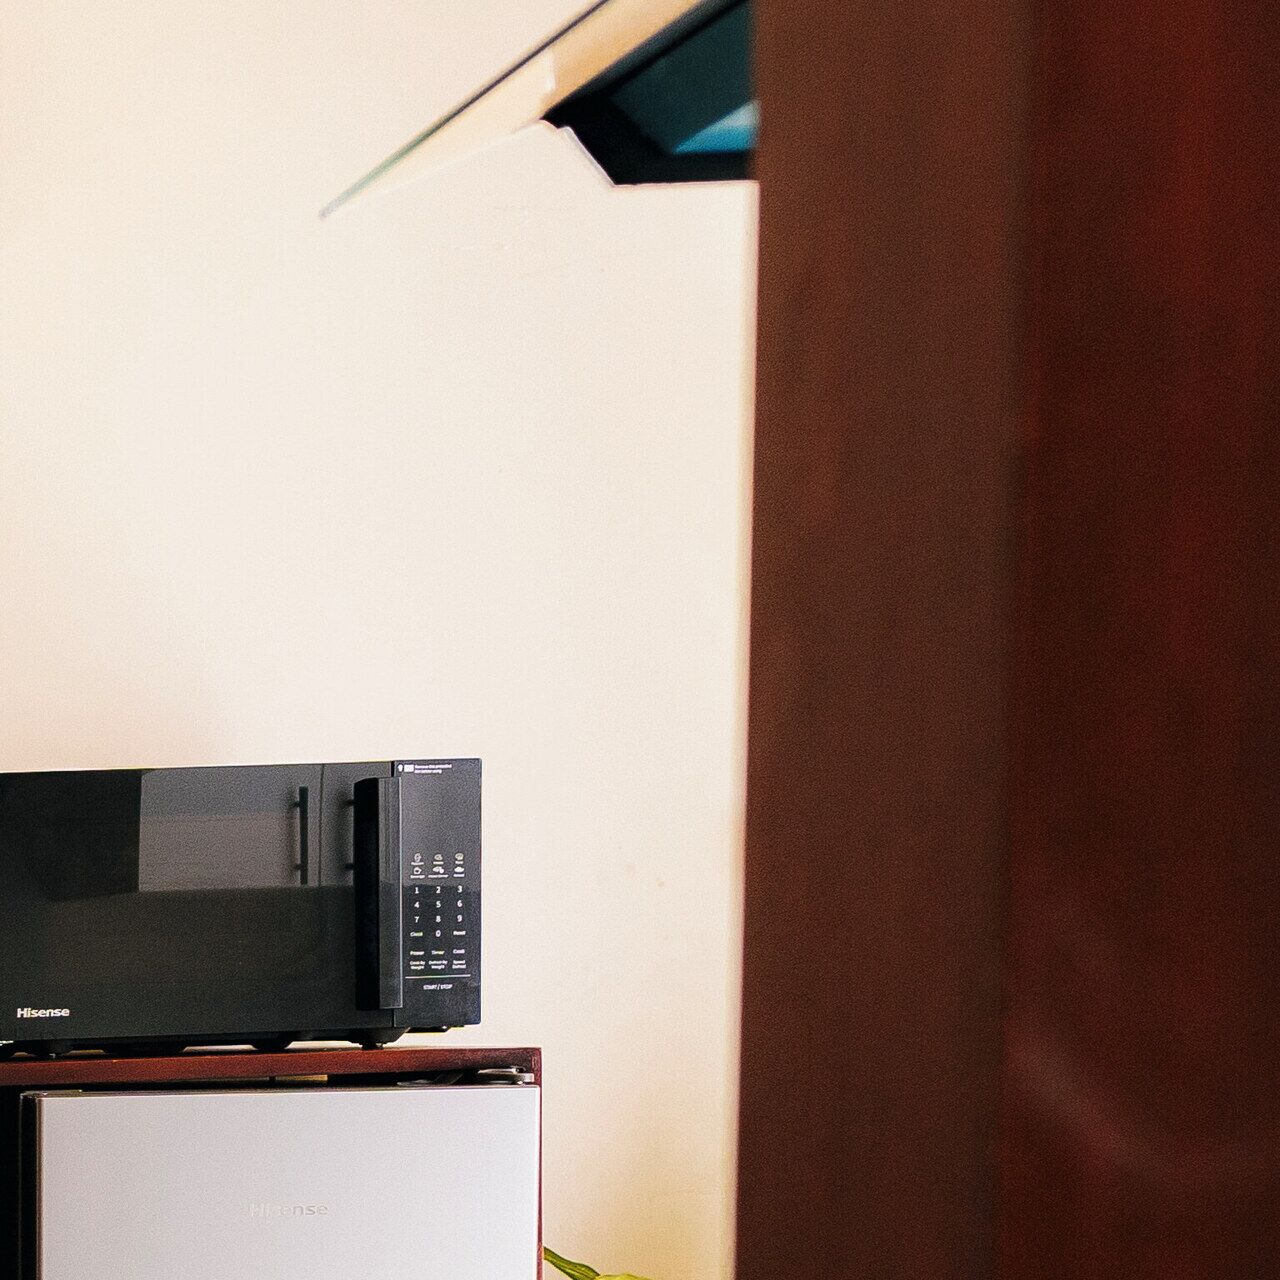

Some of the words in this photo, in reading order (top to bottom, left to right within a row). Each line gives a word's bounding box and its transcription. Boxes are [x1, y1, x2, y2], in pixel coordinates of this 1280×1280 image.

[414, 886, 420, 894] 1
[435, 886, 441, 894] 2
[456, 885, 463, 893] 3
[435, 900, 442, 908] 5
[456, 899, 463, 907] 6
[435, 915, 442, 923] 8
[456, 914, 463, 922] 9
[16, 1007, 70, 1018] Hisense
